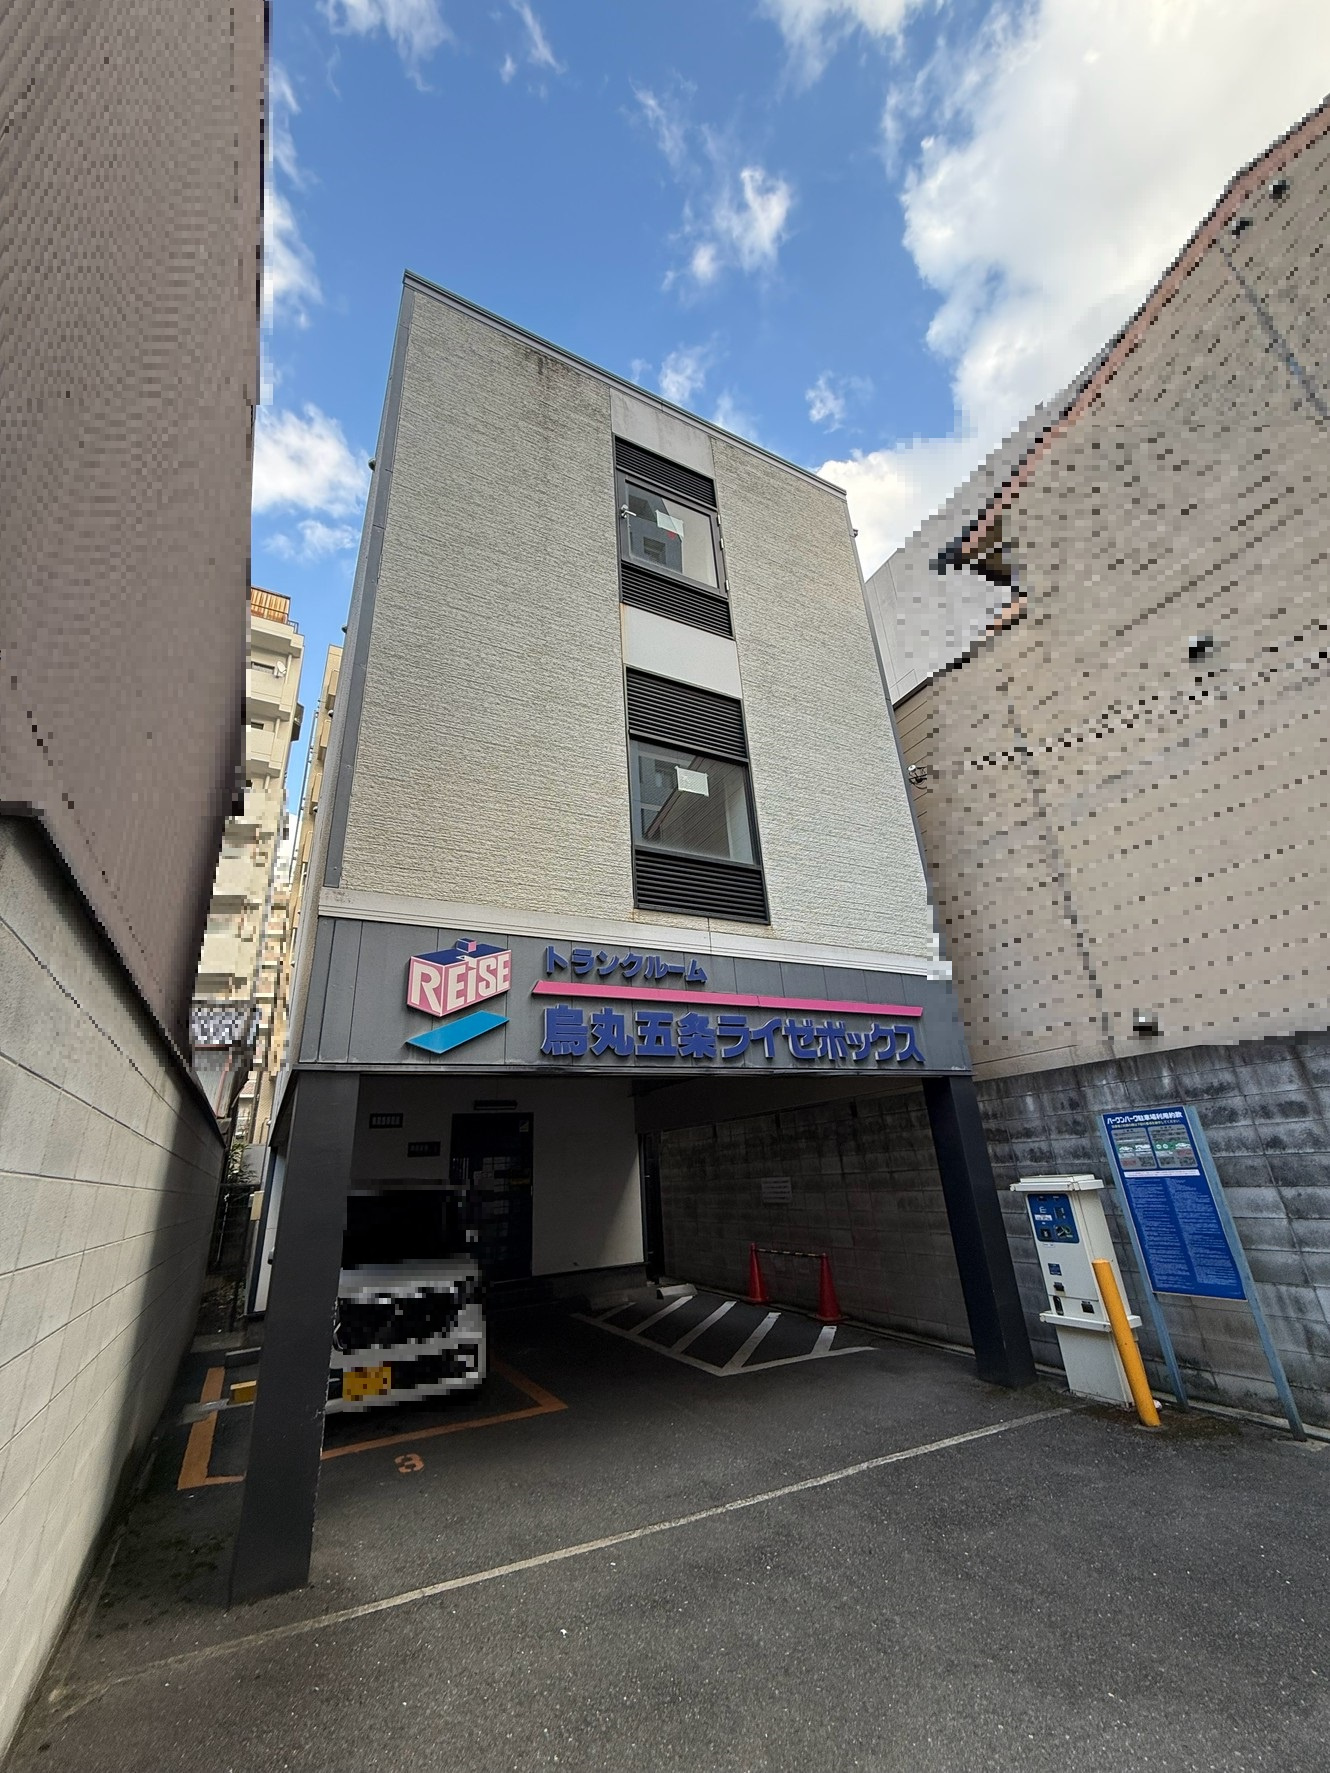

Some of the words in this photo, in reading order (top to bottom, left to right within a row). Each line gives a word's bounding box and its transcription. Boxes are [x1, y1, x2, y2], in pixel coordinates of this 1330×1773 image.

[546, 945, 708, 983] トランクルーム
[540, 1004, 926, 1064] 烏丸五条ライゼボックス
[394, 1453, 424, 1473] 3
